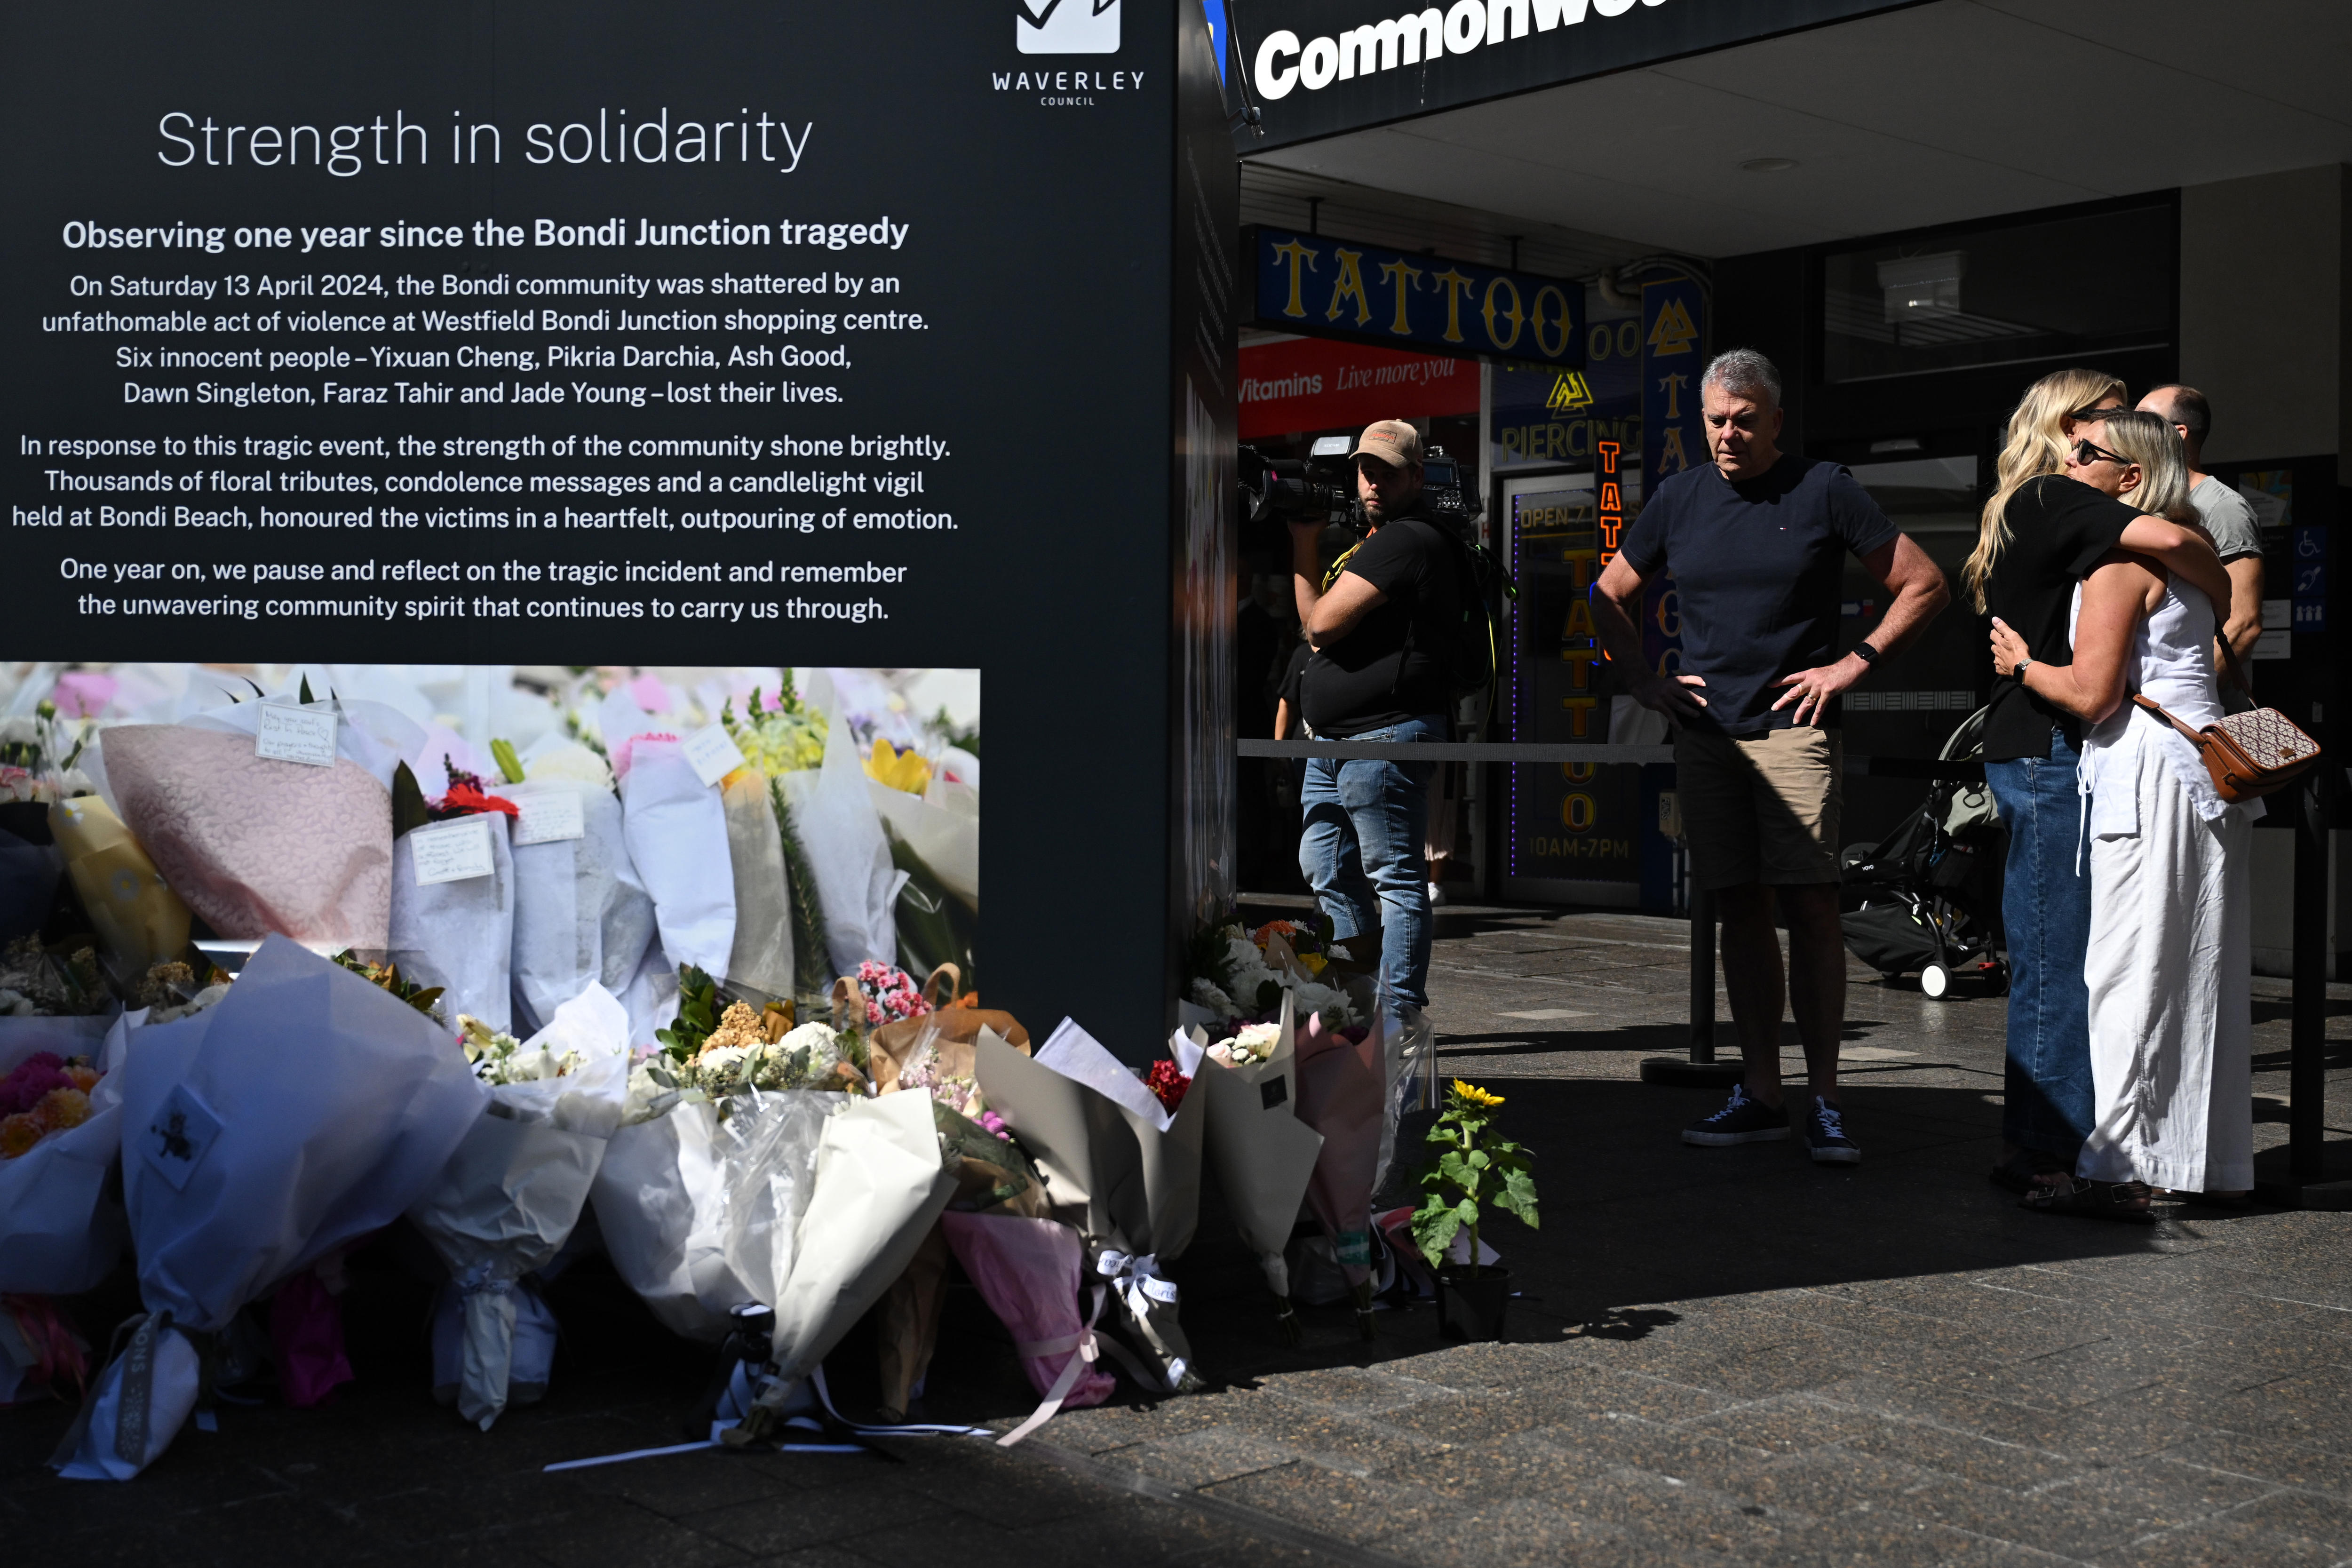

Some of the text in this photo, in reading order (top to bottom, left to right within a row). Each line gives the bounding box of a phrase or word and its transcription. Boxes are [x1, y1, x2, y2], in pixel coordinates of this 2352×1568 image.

[992, 71, 1144, 90] WAVERLEY
[1041, 97, 1094, 106] COUNCIL
[158, 107, 813, 177] Strength in solidarity
[63, 215, 909, 254] Observing one year since the Bondi Junction tragedy
[70, 271, 899, 300] On Saturday 13 April 2024, the Bondi community was shattered by an
[1271, 238, 1572, 358] TATTOO
[43, 308, 929, 334] unfathomable act of violence at Westfield Bondi Junction shopping centre.
[116, 346, 153, 367] Six
[160, 346, 262, 367] innocent
[457, 345, 540, 372] Cheng,
[548, 345, 615, 367] Pikria
[623, 345, 720, 370] Darchia,
[727, 344, 773, 366] Ash
[780, 344, 851, 369] Good,
[125, 382, 189, 403] Dawn
[196, 382, 316, 407] Singleton,
[324, 382, 388, 403] Faraz
[394, 382, 454, 403] Tahir
[460, 381, 503, 403] and
[510, 381, 565, 403] Jade
[718, 381, 776, 403] their
[783, 381, 843, 403] lives.
[1238, 357, 1455, 403] Vitamins Live more you
[21, 434, 950, 461] In response to this tragic event, the strength of the community shone brightly.
[1502, 415, 1642, 461] PIERCING
[44, 470, 924, 497] Thousands of floral tributes, condolence messages and a candlelight vigil
[13, 505, 958, 533] held at Bondi Beach, honoured the victims in a heartfelt, outpouring of emotion.
[1520, 506, 1569, 528] OPEN
[1575, 505, 1588, 523] 7
[60, 557, 907, 586] One year on, we pause and reflect on the tragic incident and remember
[78, 593, 889, 623] the unwavering community spirit that continues to carry us through.
[1529, 836, 1630, 859] 10AM-7PM
